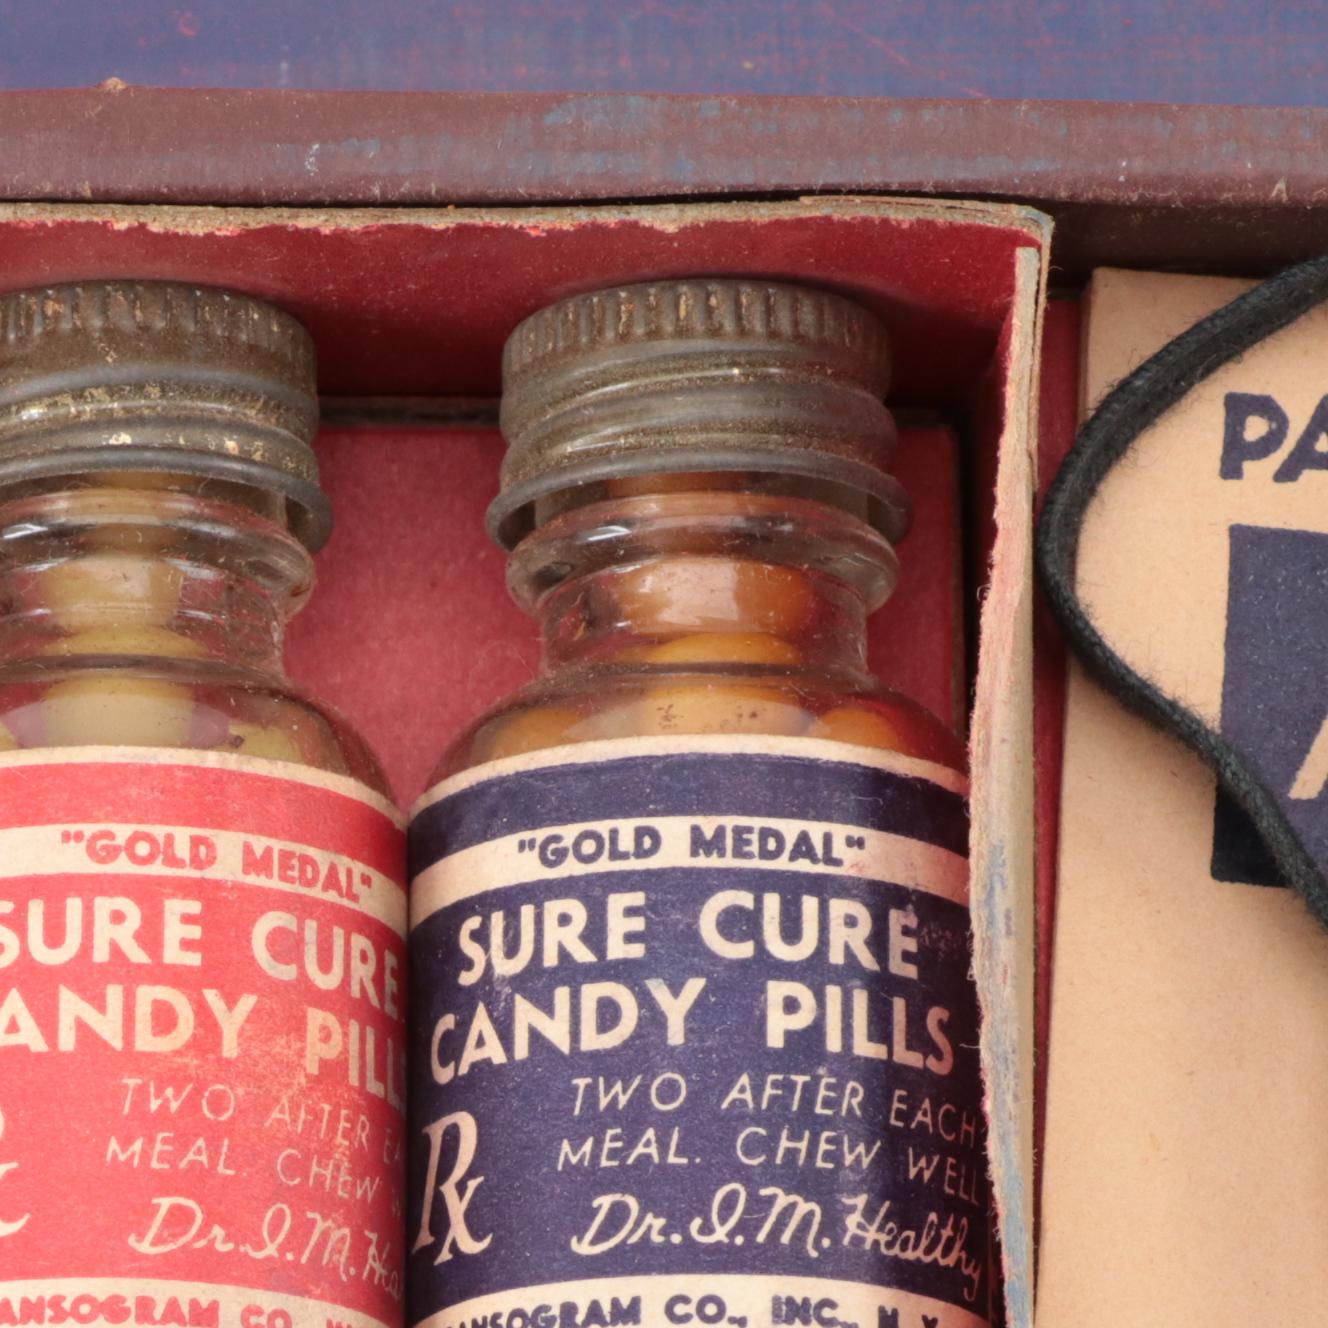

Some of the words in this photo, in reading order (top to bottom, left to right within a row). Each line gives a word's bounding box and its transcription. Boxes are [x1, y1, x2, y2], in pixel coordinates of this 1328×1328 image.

[60, 829, 217, 870] "GOLD
[241, 840, 373, 903] MEDAL"
[517, 823, 662, 868] "GOLD
[689, 824, 865, 868] MEDAL"
[251, 910, 399, 1021] CURE
[457, 890, 647, 987] SURE
[699, 889, 920, 980] CURE
[430, 977, 707, 1086] CANDY
[765, 980, 954, 1076] PILLS
[121, 1077, 236, 1121] TWO
[264, 1095, 371, 1153] AFTER
[571, 1073, 688, 1116] TWO
[720, 1072, 865, 1118] AFTER
[890, 1089, 977, 1149] EACH
[276, 1148, 381, 1205] CHEW
[557, 1126, 701, 1171] MEAL.
[736, 1126, 882, 1169] CHEW
[906, 1146, 982, 1206] WELL
[841, 1194, 982, 1302] Healthy
[663, 1293, 747, 1328] CO.,
